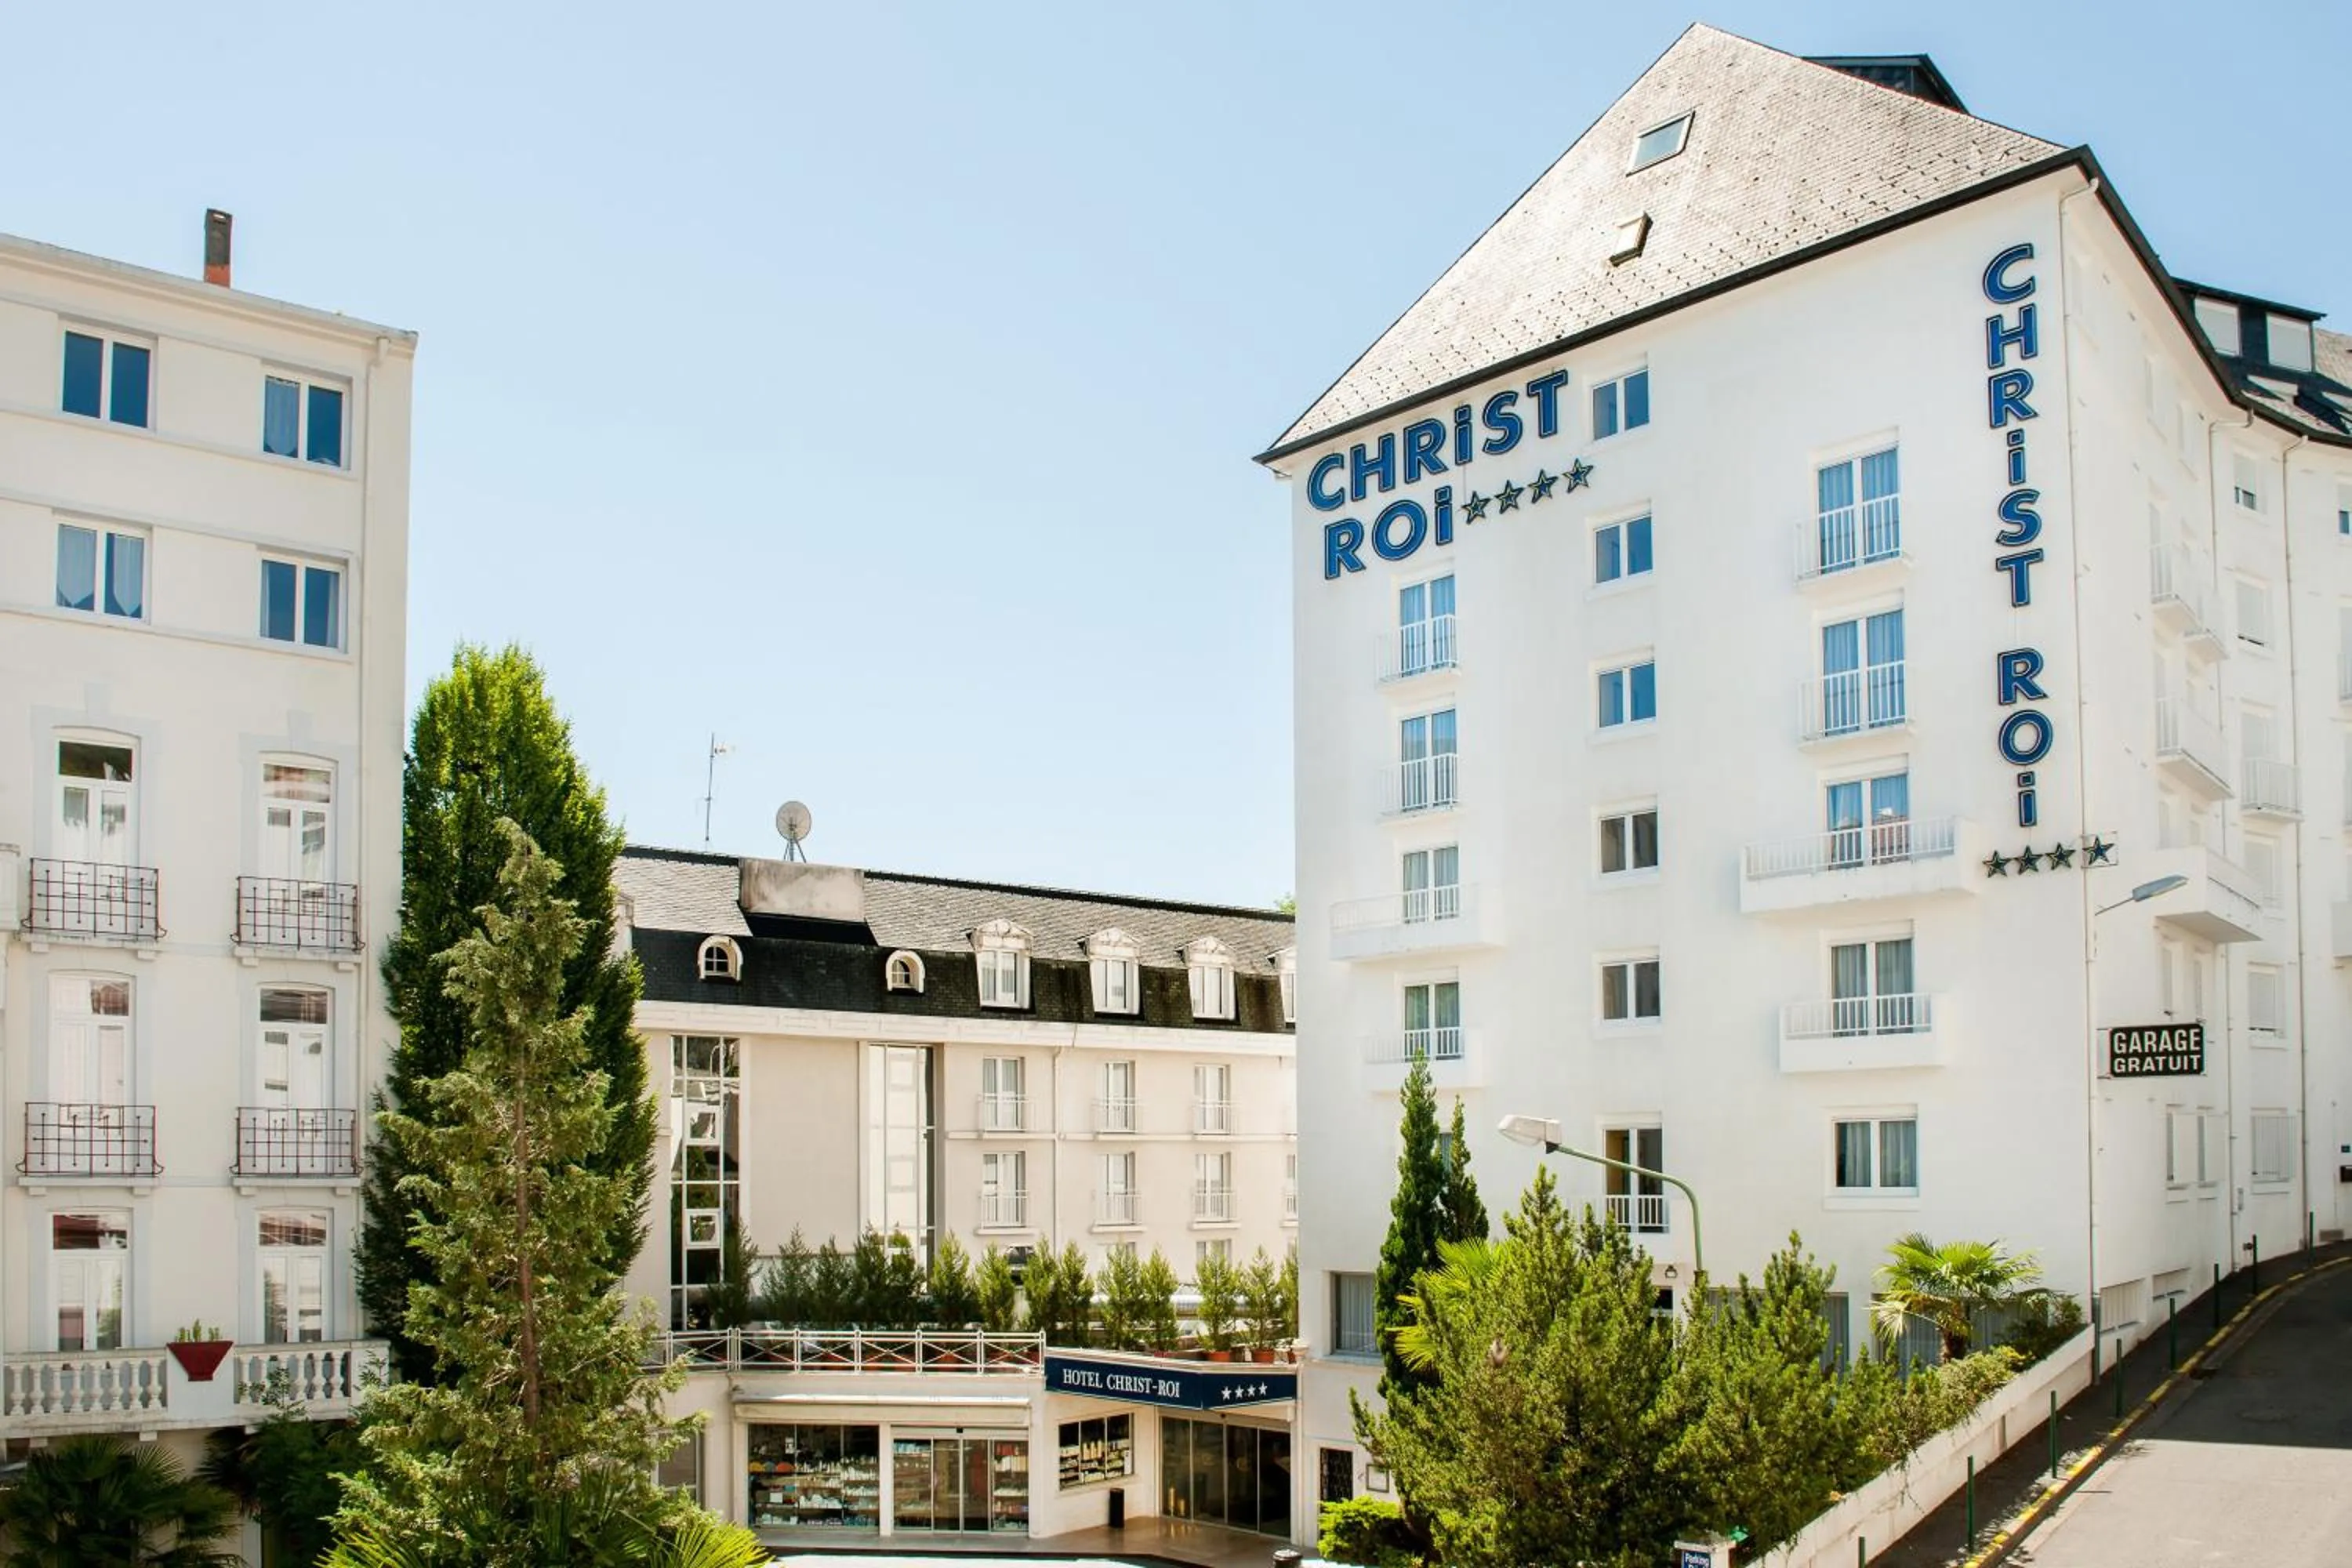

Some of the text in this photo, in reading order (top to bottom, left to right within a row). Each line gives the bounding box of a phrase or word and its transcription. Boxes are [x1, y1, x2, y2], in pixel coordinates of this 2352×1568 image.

[2114, 1029, 2201, 1054] GARAGE
[2114, 1054, 2201, 1073] GRATUIT
[1062, 1368, 1180, 1398] HOTEL CHRIST-ROI
